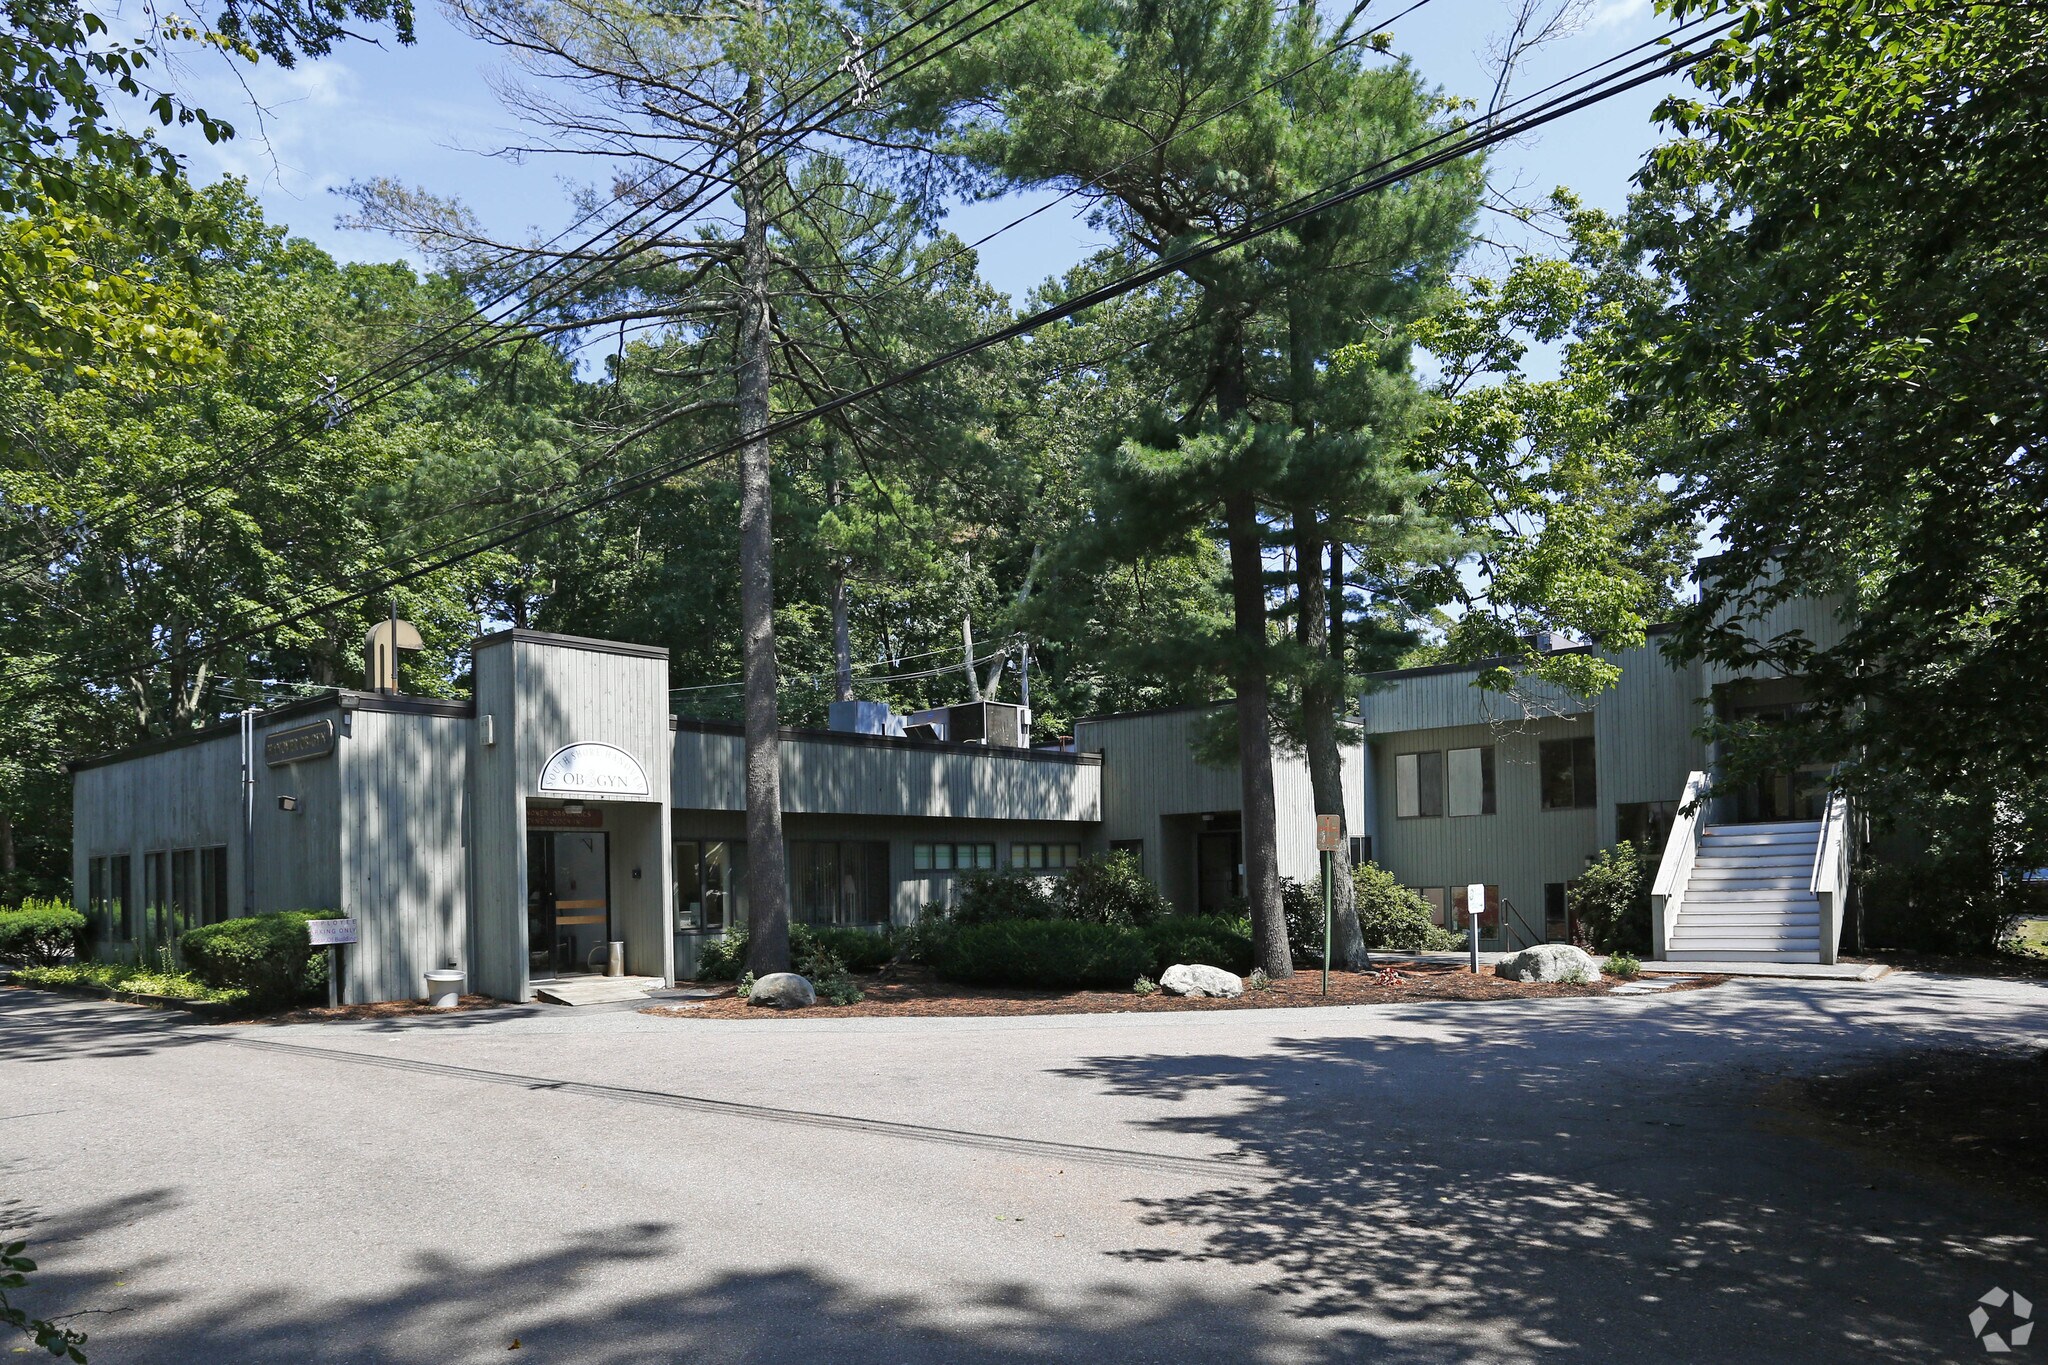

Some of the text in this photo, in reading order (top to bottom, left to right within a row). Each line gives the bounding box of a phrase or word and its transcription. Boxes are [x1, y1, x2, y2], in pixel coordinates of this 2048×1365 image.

[545, 748, 644, 790] SOUTH SHORE HANOVER
[563, 772, 628, 787] OB GYN
